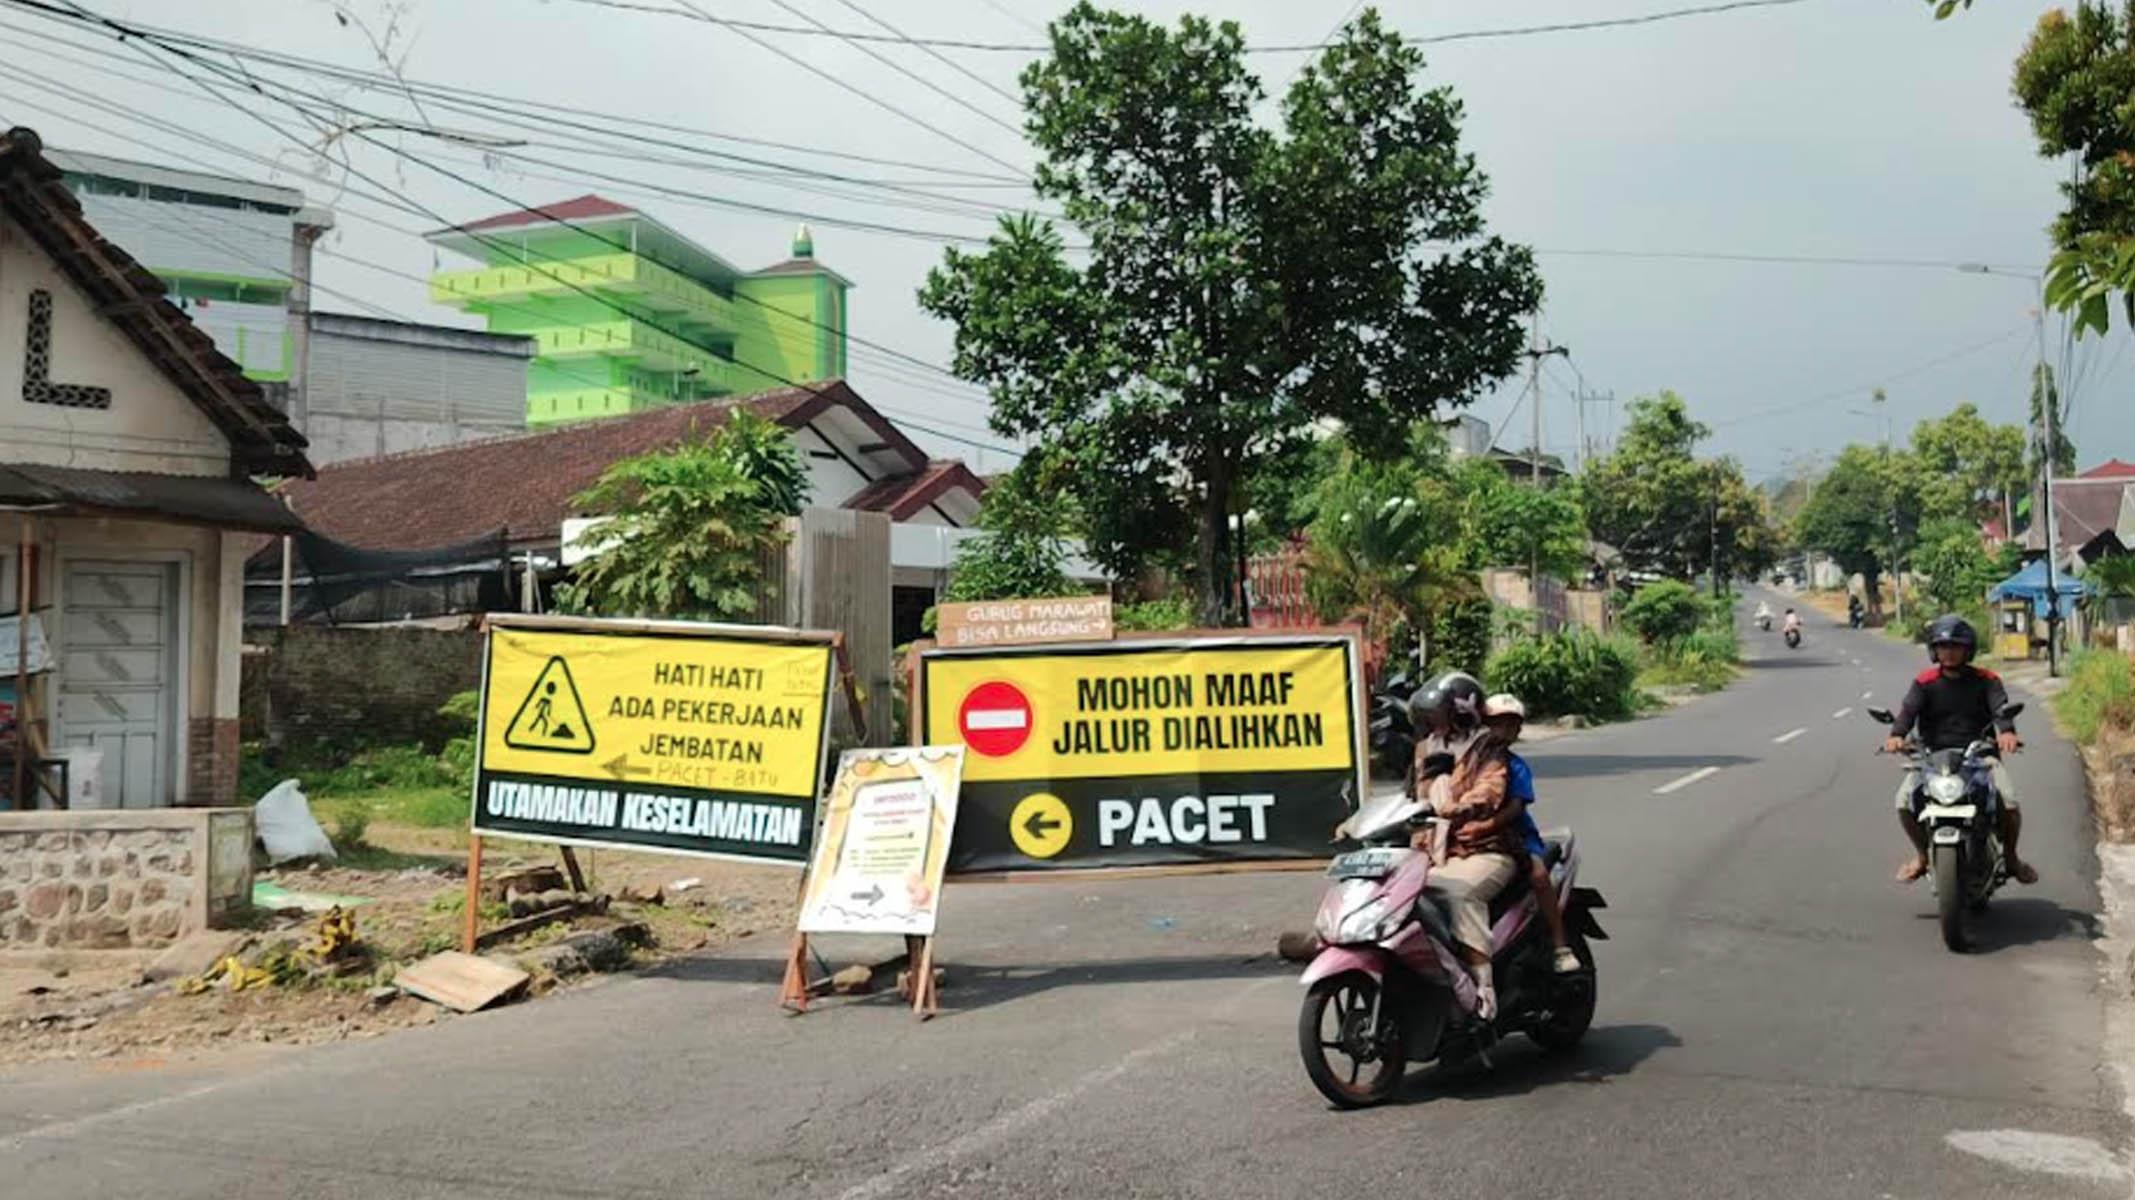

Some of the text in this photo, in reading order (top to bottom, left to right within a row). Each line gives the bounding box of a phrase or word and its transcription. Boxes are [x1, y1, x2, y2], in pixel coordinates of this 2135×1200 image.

[654, 662, 704, 688] HATI
[712, 666, 764, 691] HATI
[1077, 672, 1294, 711] MOHON MAAF
[608, 696, 804, 730] ADA PEKERJAAN
[640, 733, 764, 764] JEMBATAN
[1053, 713, 1323, 755] JALUR DIALIHKAN
[656, 760, 717, 787] PACET
[487, 780, 802, 845] UTAMAKAN KESELAMATAN
[1098, 793, 1276, 846] PACET
